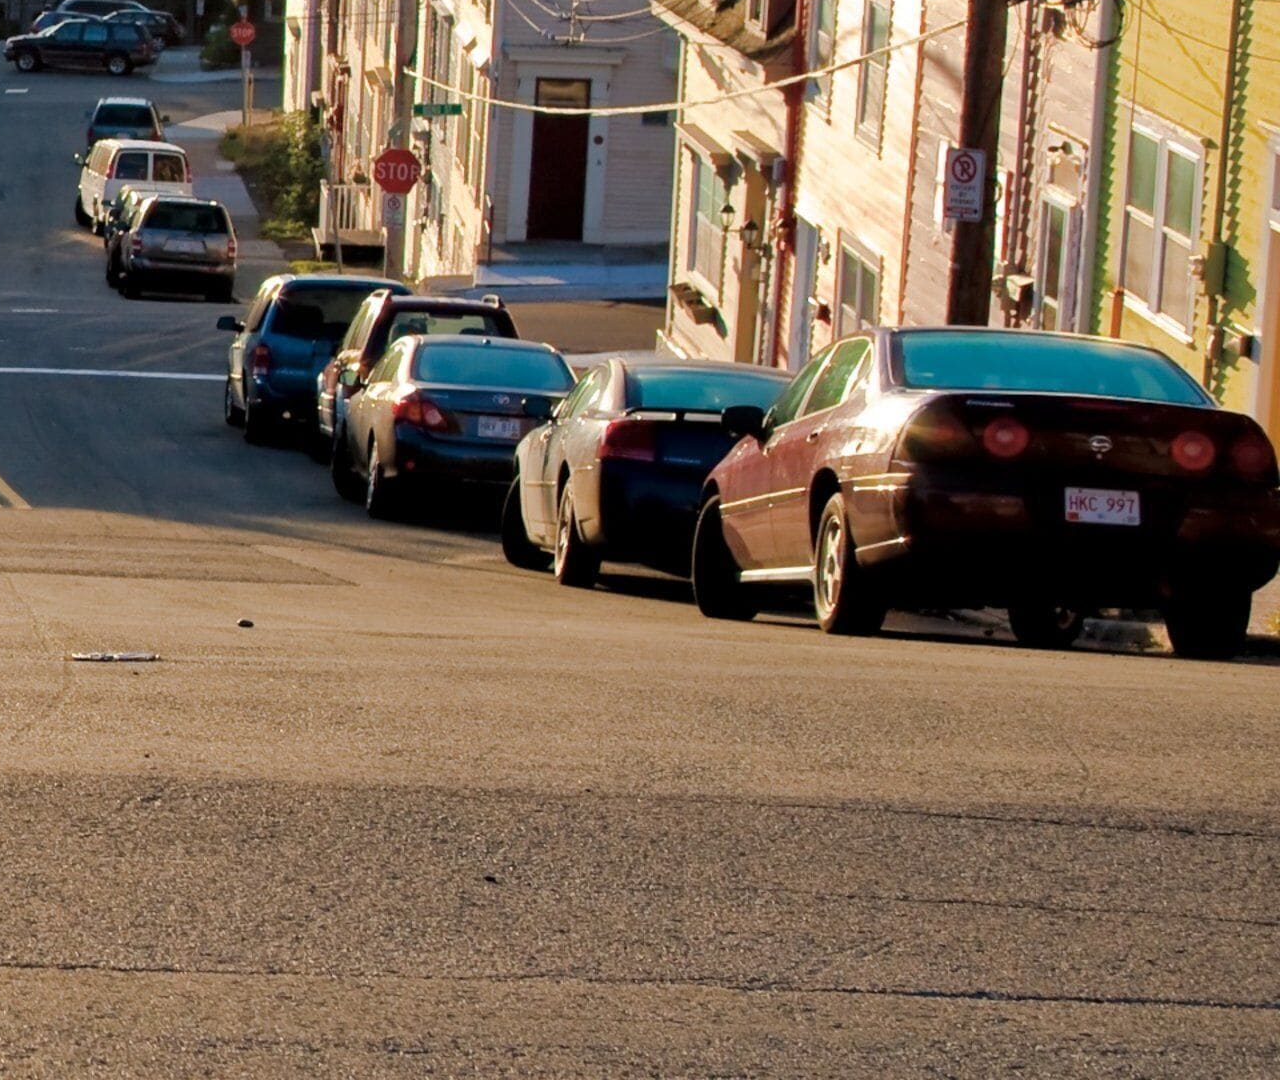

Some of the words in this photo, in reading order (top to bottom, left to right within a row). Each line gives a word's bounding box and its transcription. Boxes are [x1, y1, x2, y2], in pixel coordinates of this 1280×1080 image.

[377, 162, 419, 181] STOP
[1068, 495, 1098, 512] HKC
[1106, 497, 1136, 514] 997
